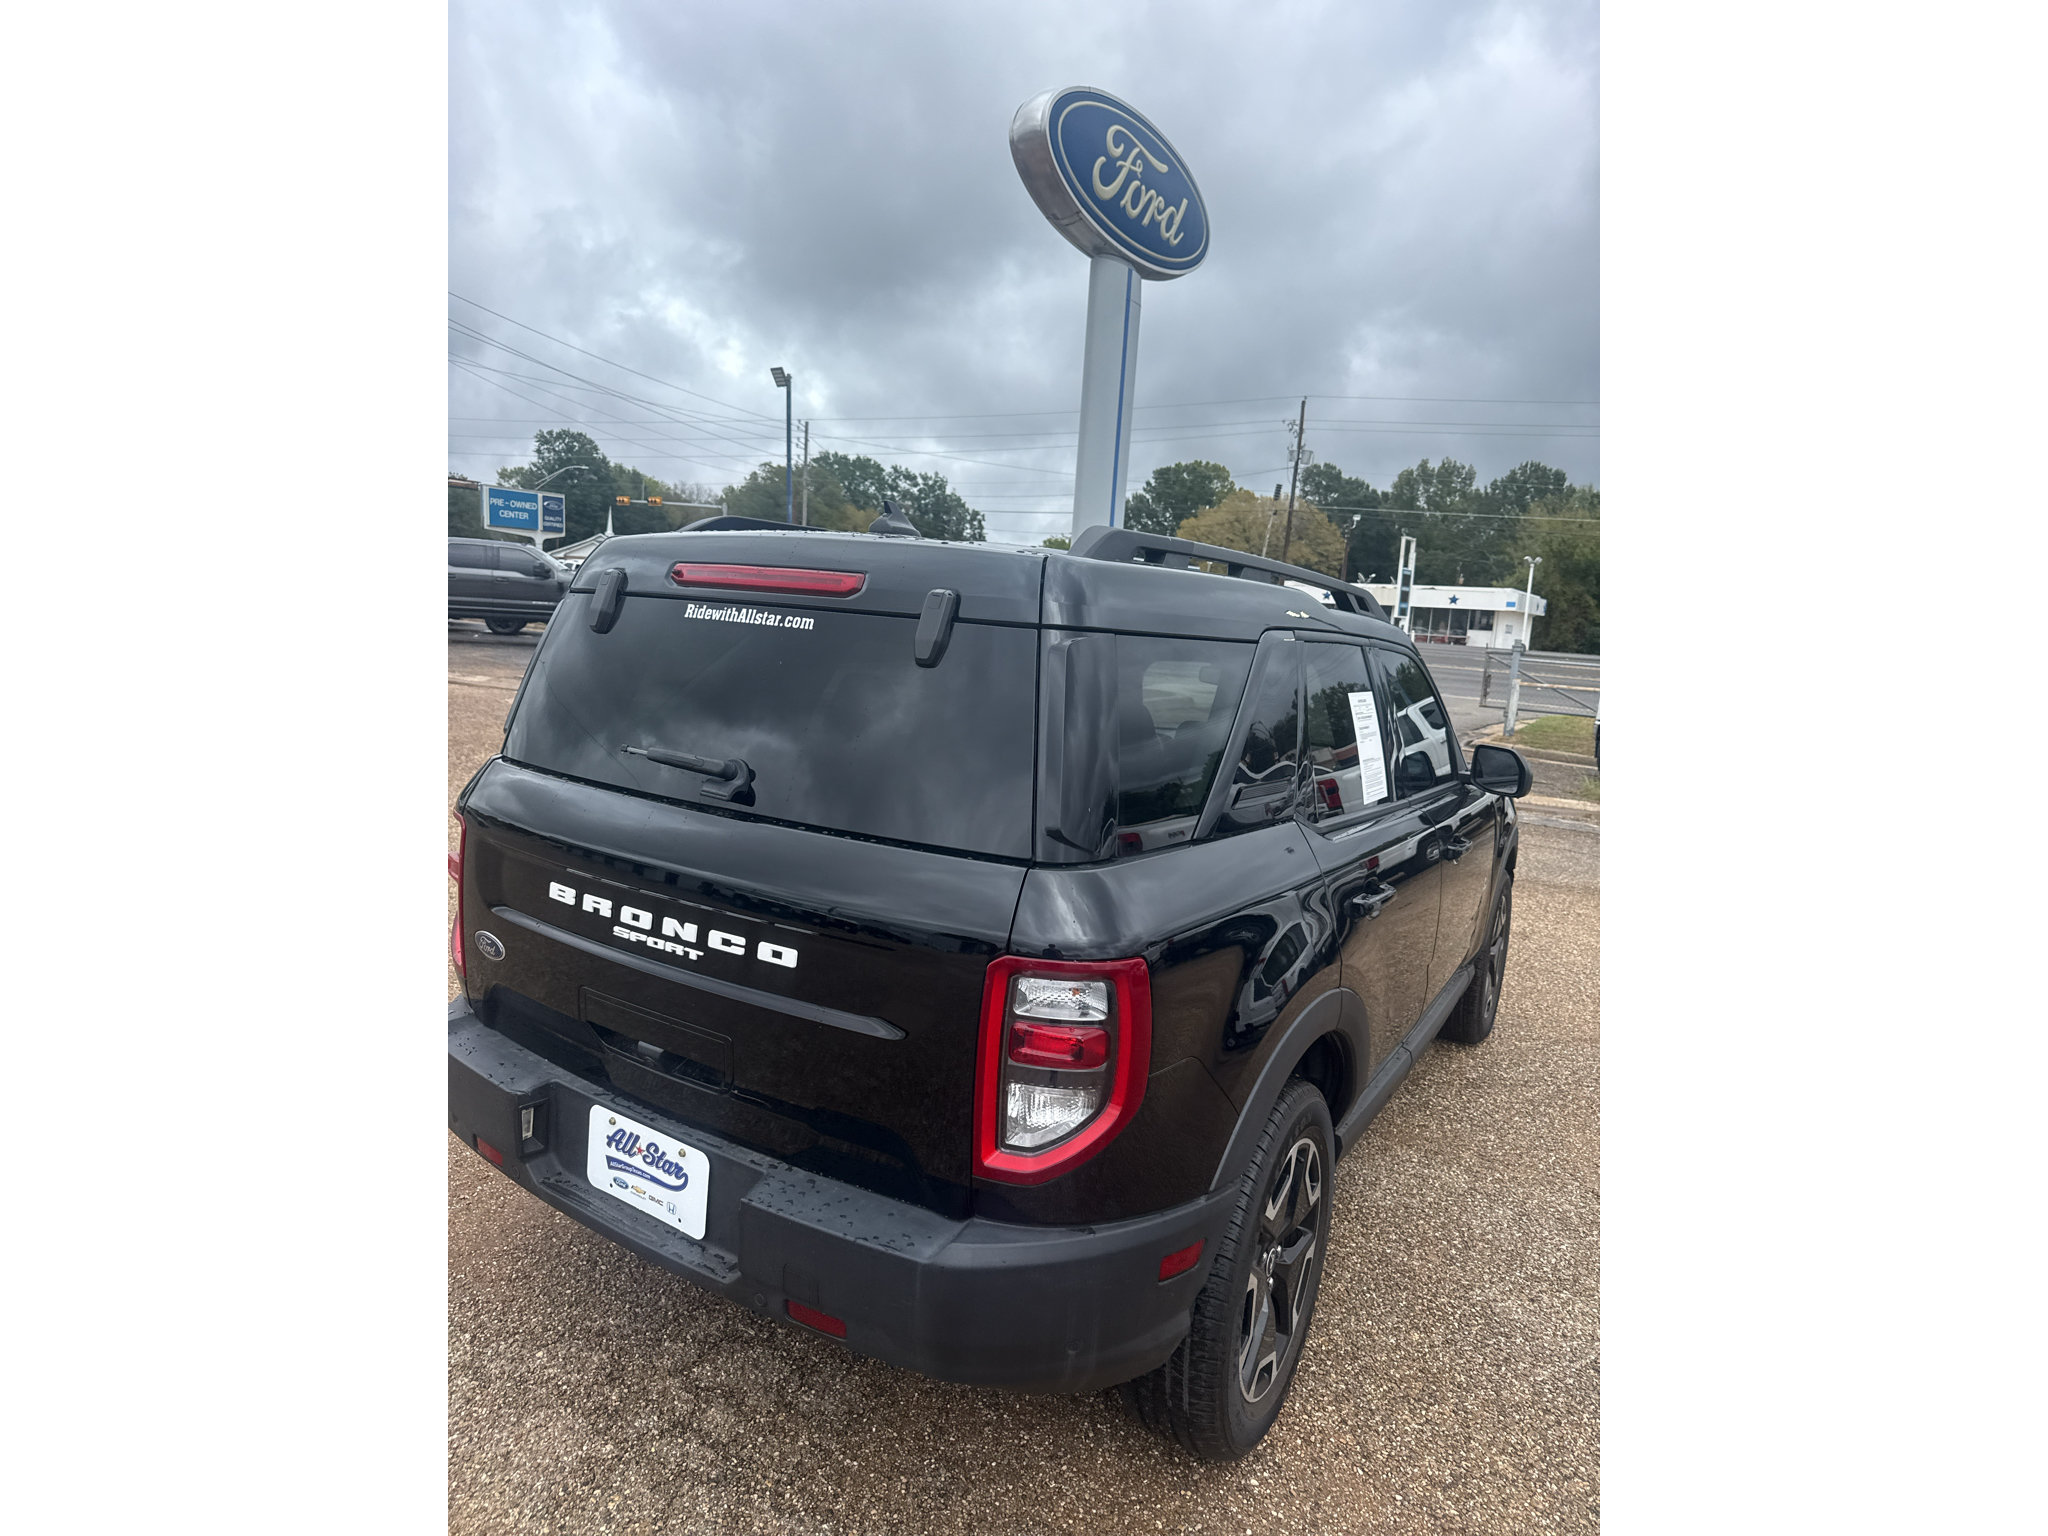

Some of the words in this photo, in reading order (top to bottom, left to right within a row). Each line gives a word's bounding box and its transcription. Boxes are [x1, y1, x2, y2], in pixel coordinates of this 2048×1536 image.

[1092, 124, 1188, 247] Ford
[499, 510, 528, 520] CENTER
[684, 603, 815, 631] RidewithAllstar.com
[548, 881, 799, 969] BRONCO
[612, 925, 705, 961] SPORT
[479, 935, 496, 956] Ford
[606, 1128, 640, 1158] All
[642, 1142, 688, 1180] Star
